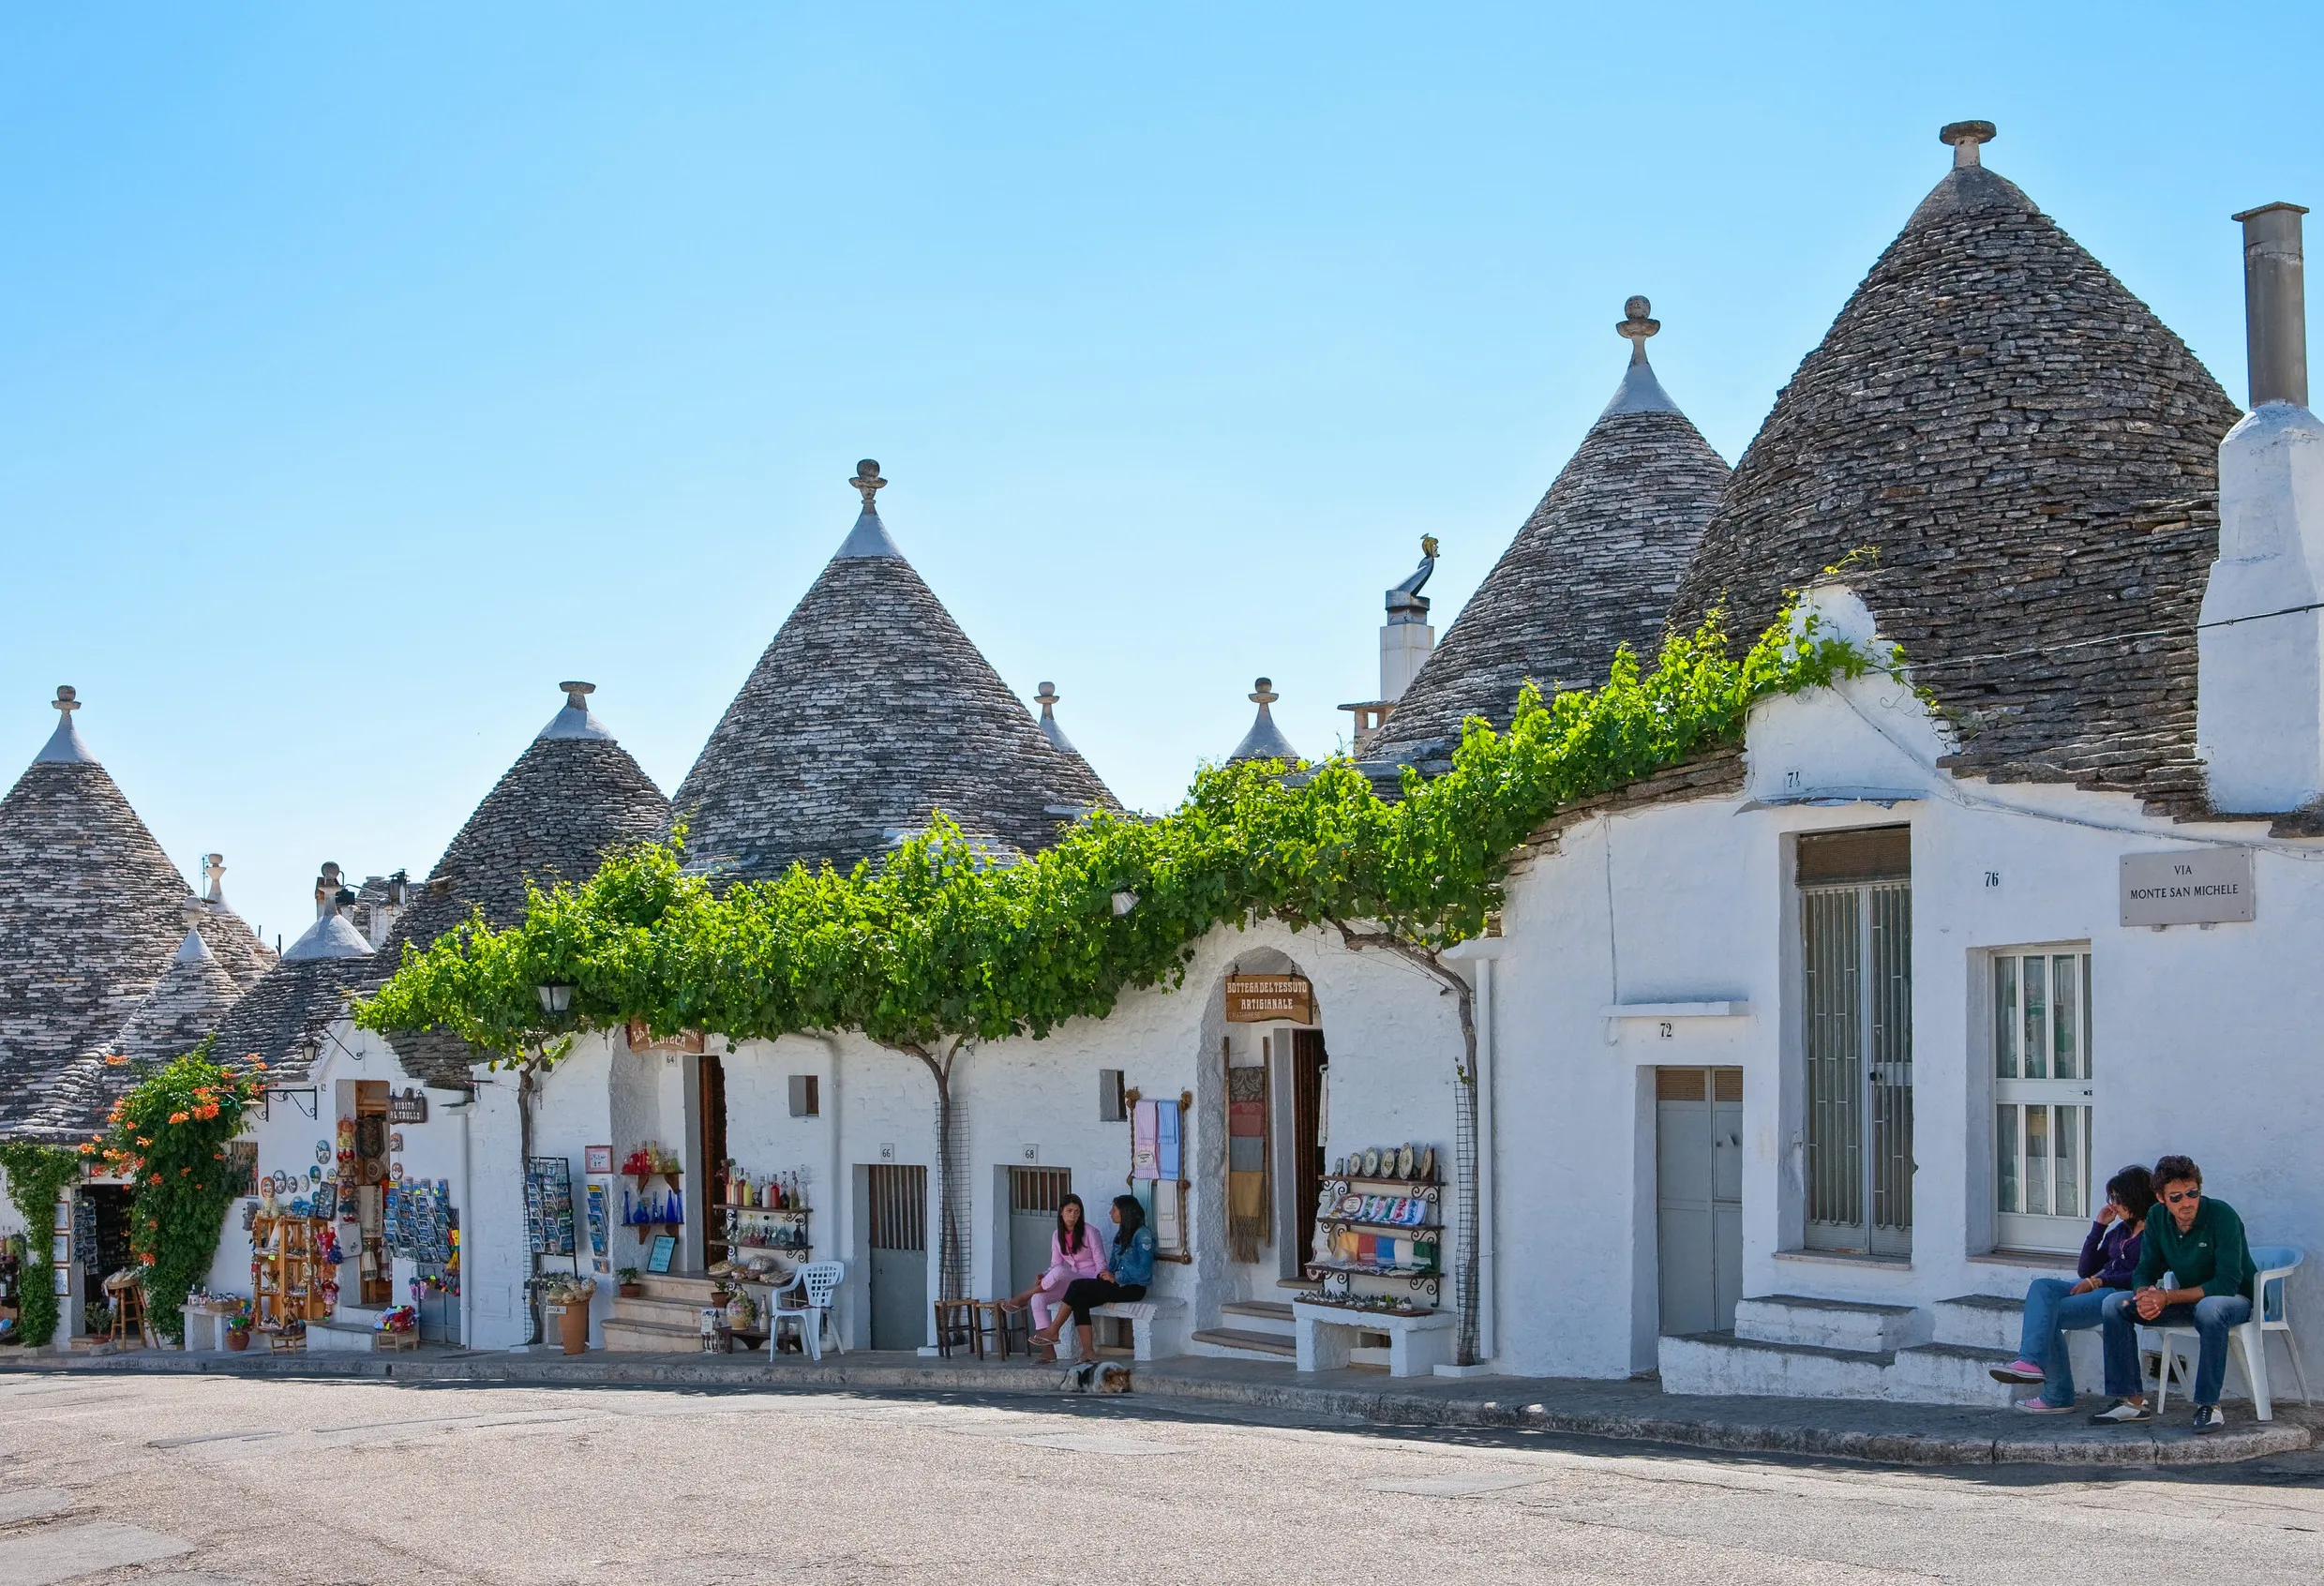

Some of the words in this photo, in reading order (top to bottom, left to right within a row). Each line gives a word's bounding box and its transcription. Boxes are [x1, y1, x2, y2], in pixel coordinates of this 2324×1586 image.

[2174, 864, 2193, 875] VIA
[1985, 872, 1999, 887] 76
[2130, 888, 2167, 900] MONTE
[2169, 886, 2191, 898] SAN
[2194, 884, 2239, 896] MICHELE
[1227, 981, 1259, 993] BOTTEGA
[1259, 981, 1274, 993] DEL
[1274, 981, 1307, 993] TESSUTO
[1241, 998, 1293, 1010] ARTIGIANALE
[633, 1027, 645, 1042] LA
[1660, 1023, 1672, 1037] 72
[666, 1055, 674, 1064] 64
[395, 1101, 415, 1110] VISITA
[390, 1111, 397, 1119] AL
[398, 1111, 420, 1120] TRULLO
[882, 1148, 892, 1158] 66
[1025, 1149, 1035, 1159] 68
